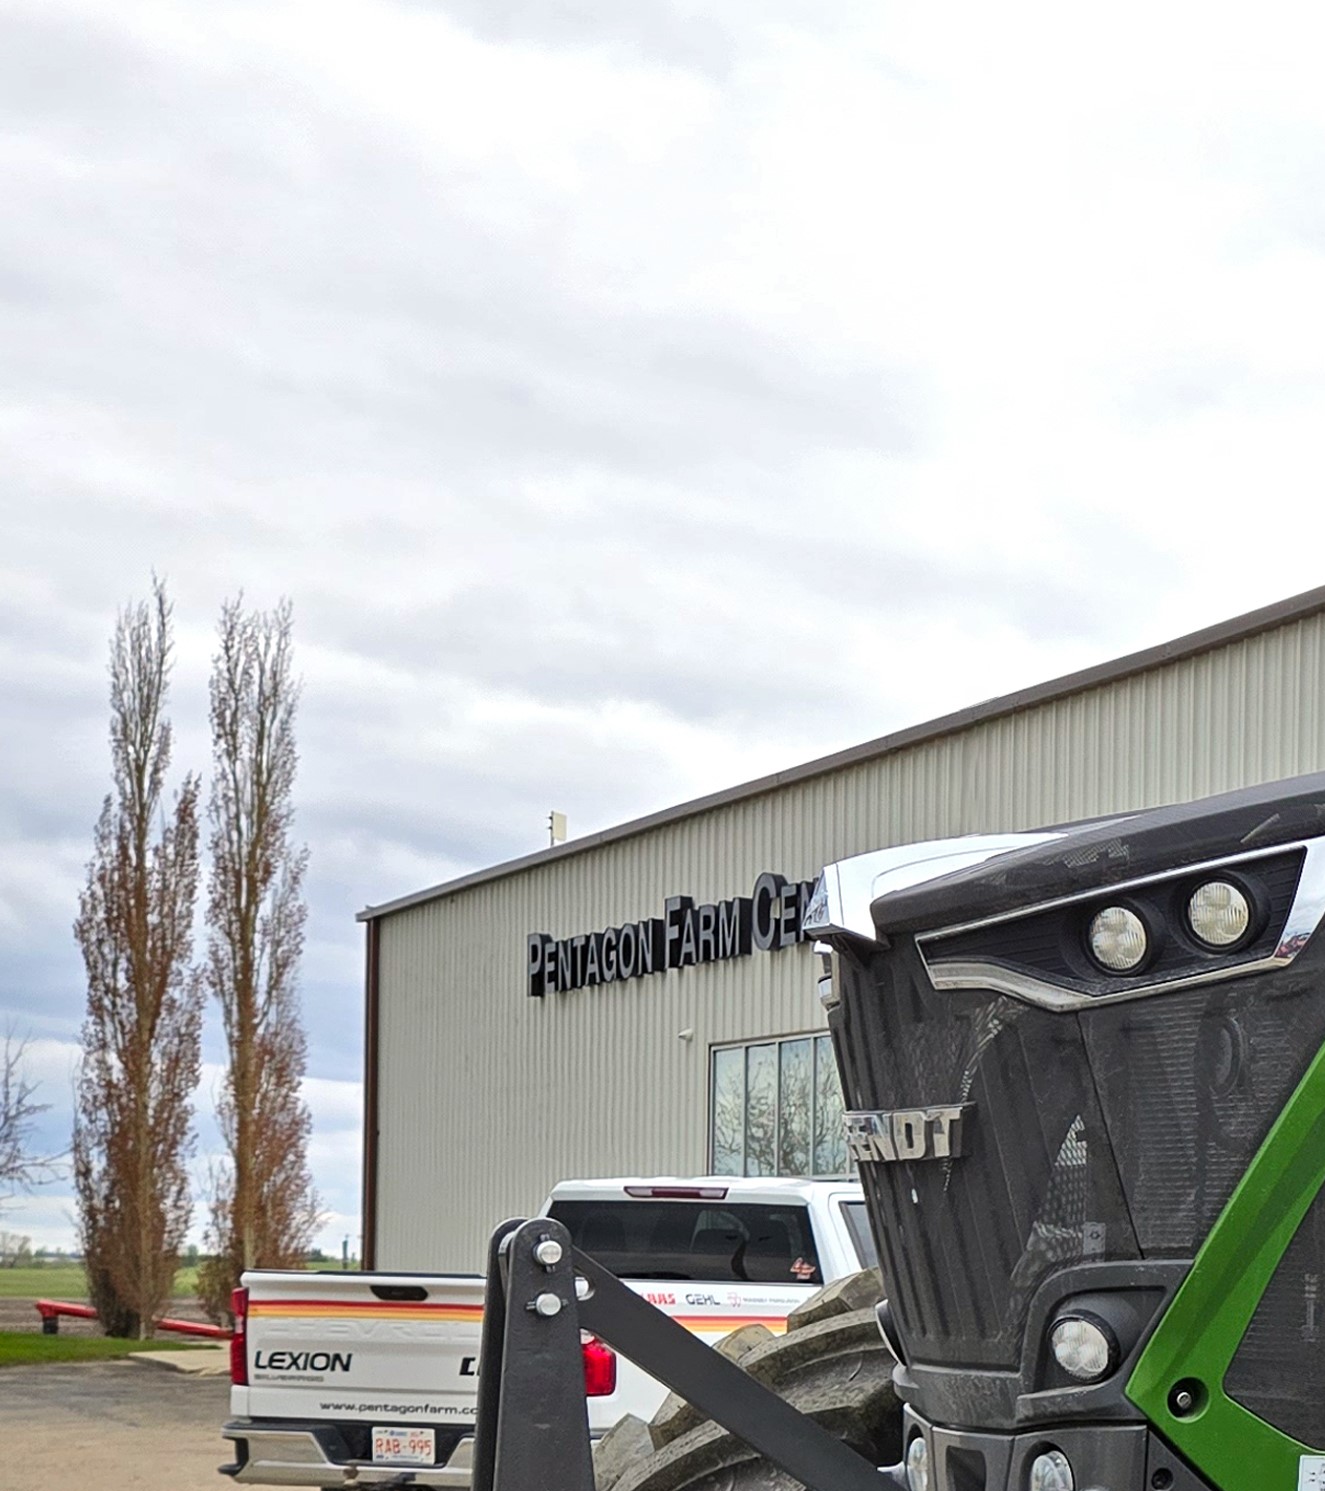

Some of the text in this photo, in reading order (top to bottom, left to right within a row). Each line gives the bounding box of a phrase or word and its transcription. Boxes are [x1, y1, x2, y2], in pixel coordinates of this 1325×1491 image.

[527, 919, 658, 997] PENTAGON
[664, 895, 748, 970] FARM
[686, 1294, 722, 1306] GEHL
[254, 1350, 352, 1372] LEXION
